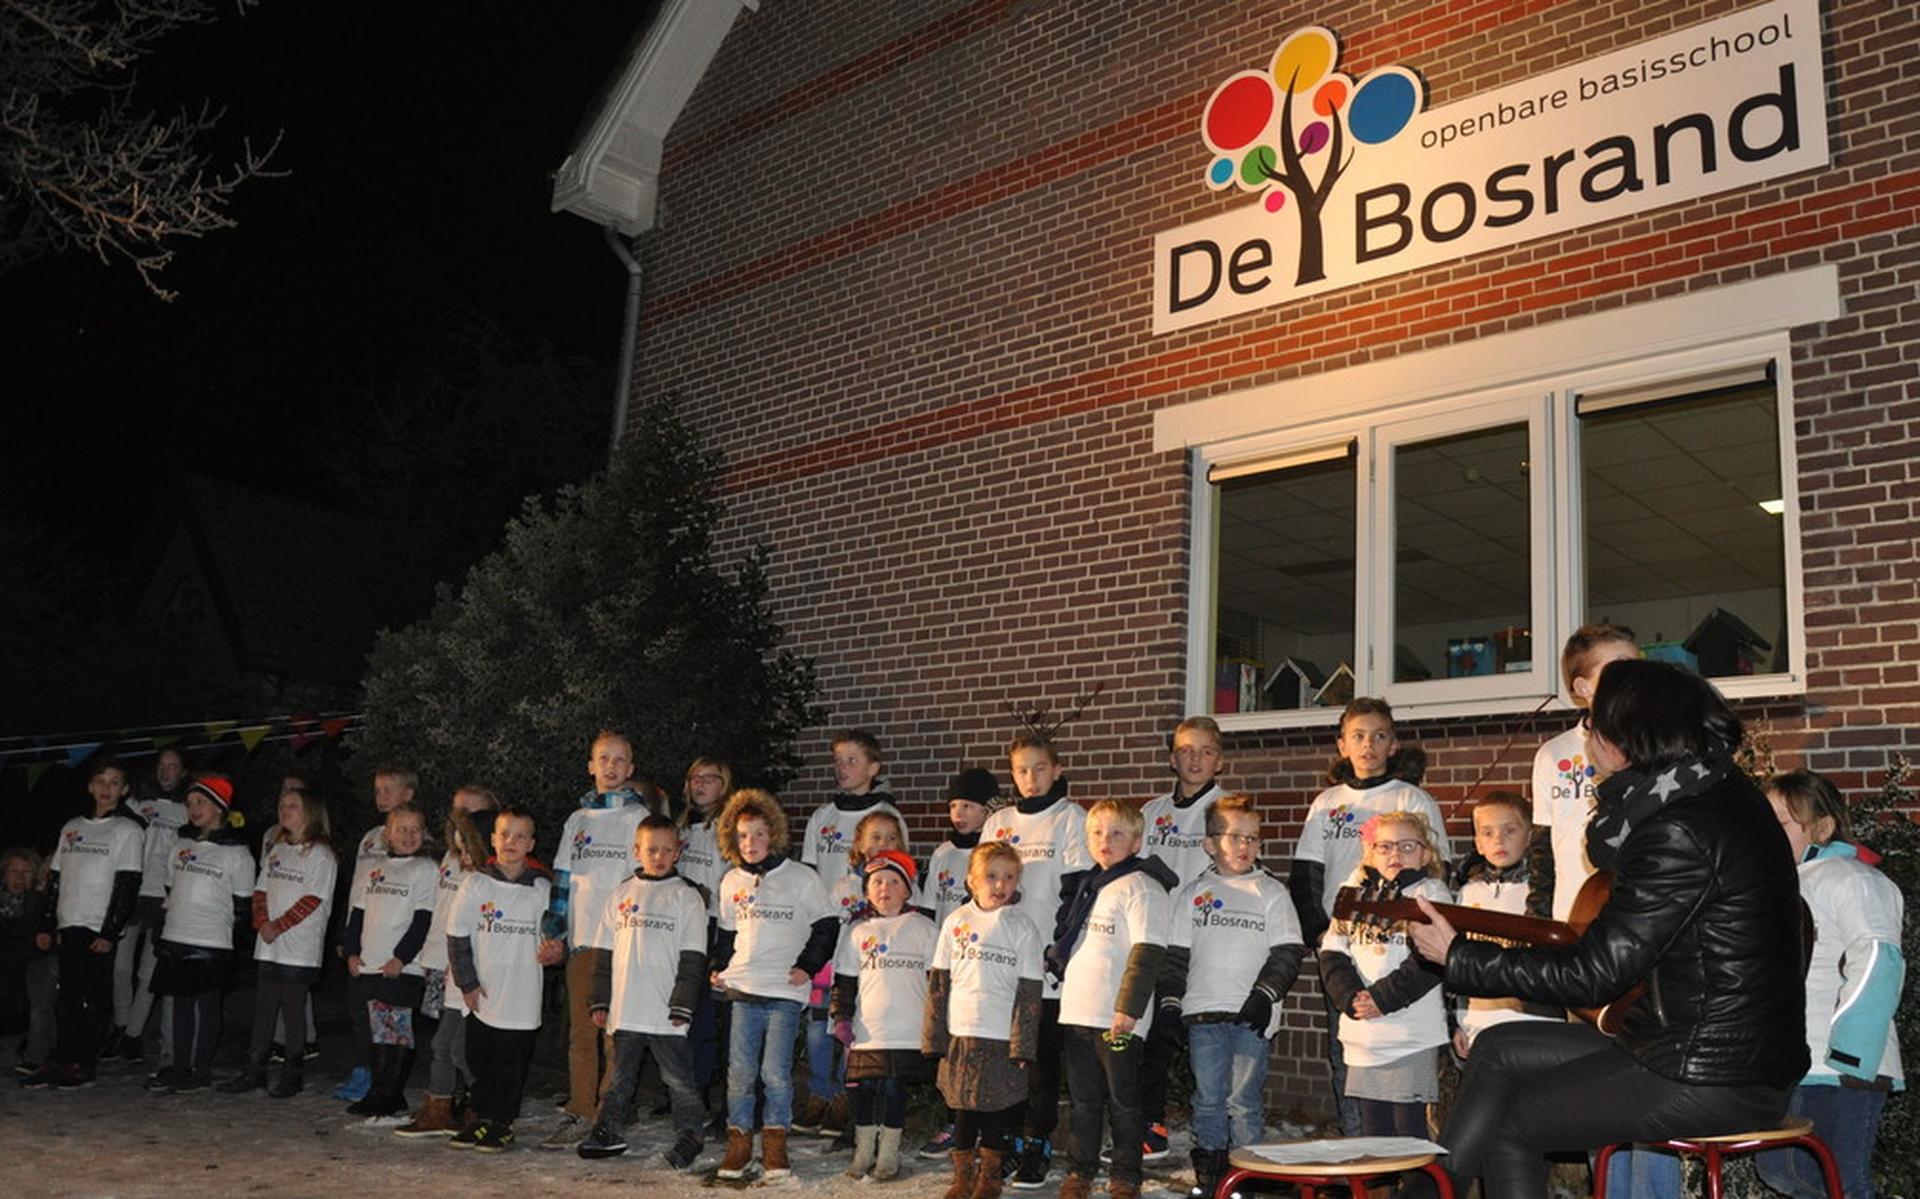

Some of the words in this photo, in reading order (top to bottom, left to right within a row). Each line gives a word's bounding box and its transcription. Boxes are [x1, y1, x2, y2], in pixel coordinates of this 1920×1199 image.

[1420, 87, 1569, 150] openbare
[1579, 14, 1793, 102] basisschool
[1169, 239, 1272, 315] De
[1356, 62, 1800, 265] Bosrand
[1551, 785, 1570, 800] De
[582, 848, 627, 860] Bosrand
[493, 922, 537, 936] Bosrand
[629, 917, 676, 932] Bosrand
[1211, 914, 1265, 932] Bosrand
[879, 957, 925, 969] Bosrand
[967, 947, 1018, 967] Bosrand
